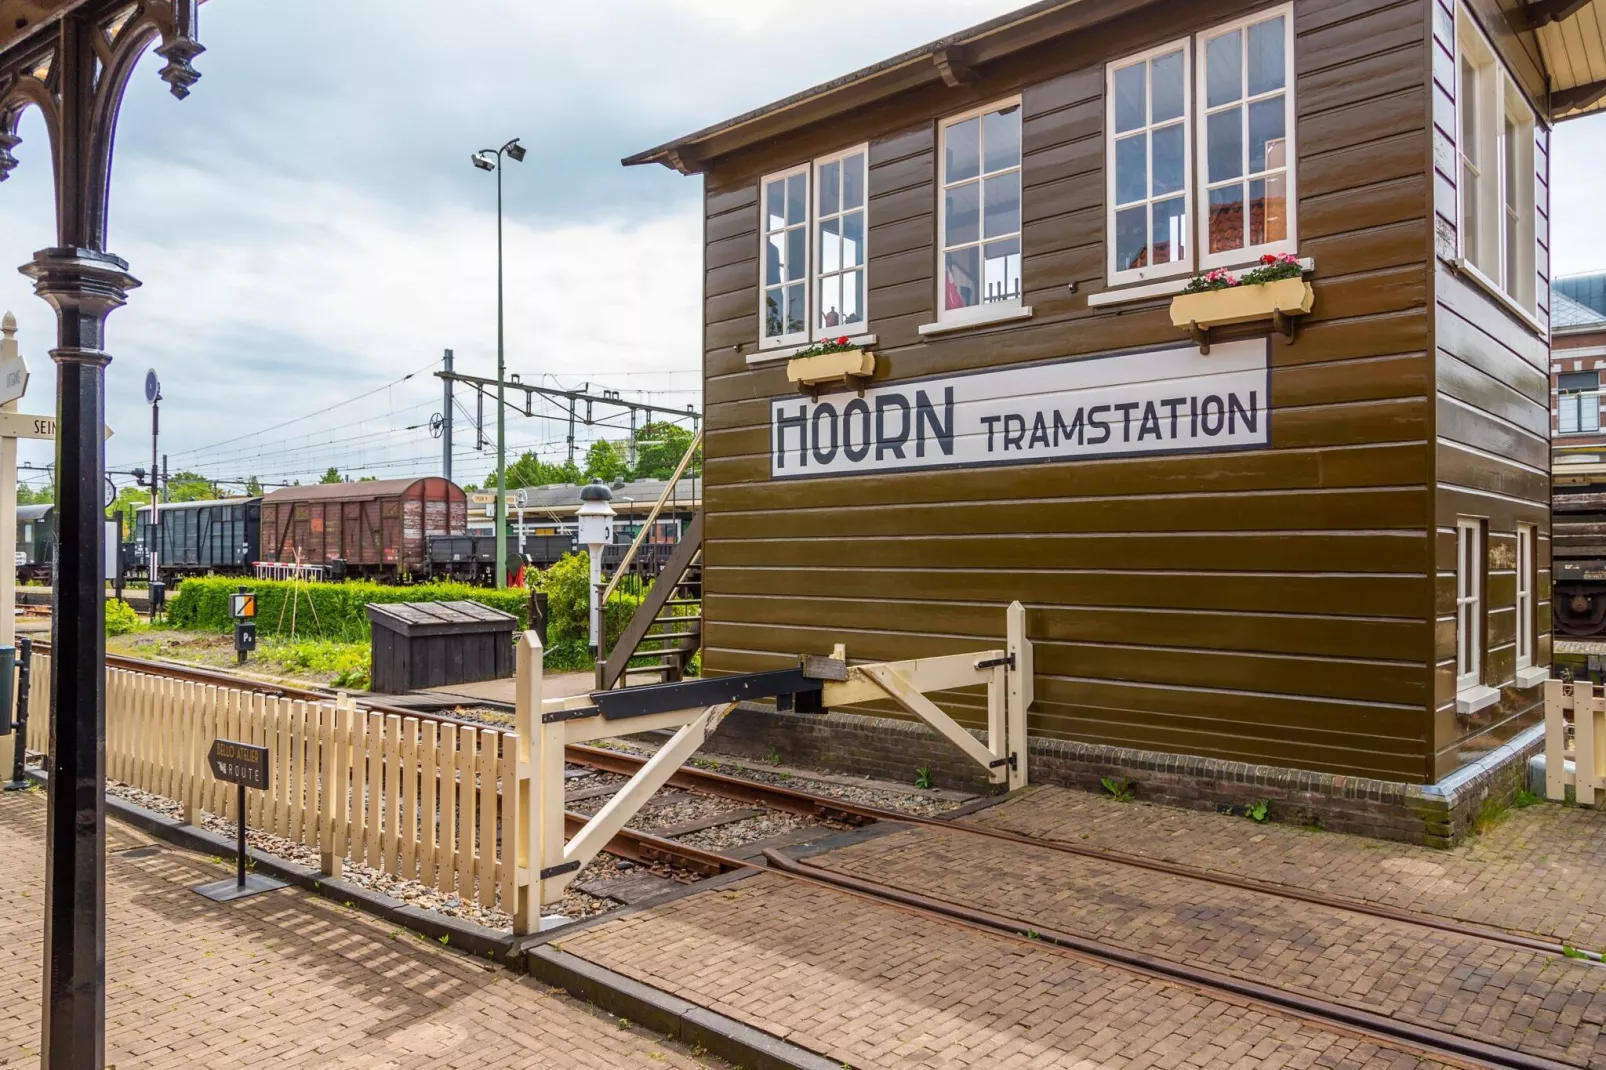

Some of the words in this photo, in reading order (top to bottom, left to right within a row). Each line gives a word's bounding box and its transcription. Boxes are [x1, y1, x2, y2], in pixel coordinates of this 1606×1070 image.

[776, 386, 955, 468] HOORN
[981, 390, 1257, 452] TRAMSTATION
[216, 742, 234, 758] BELLO
[237, 748, 259, 763] ATELIER
[228, 763, 259, 782] ROUTE
